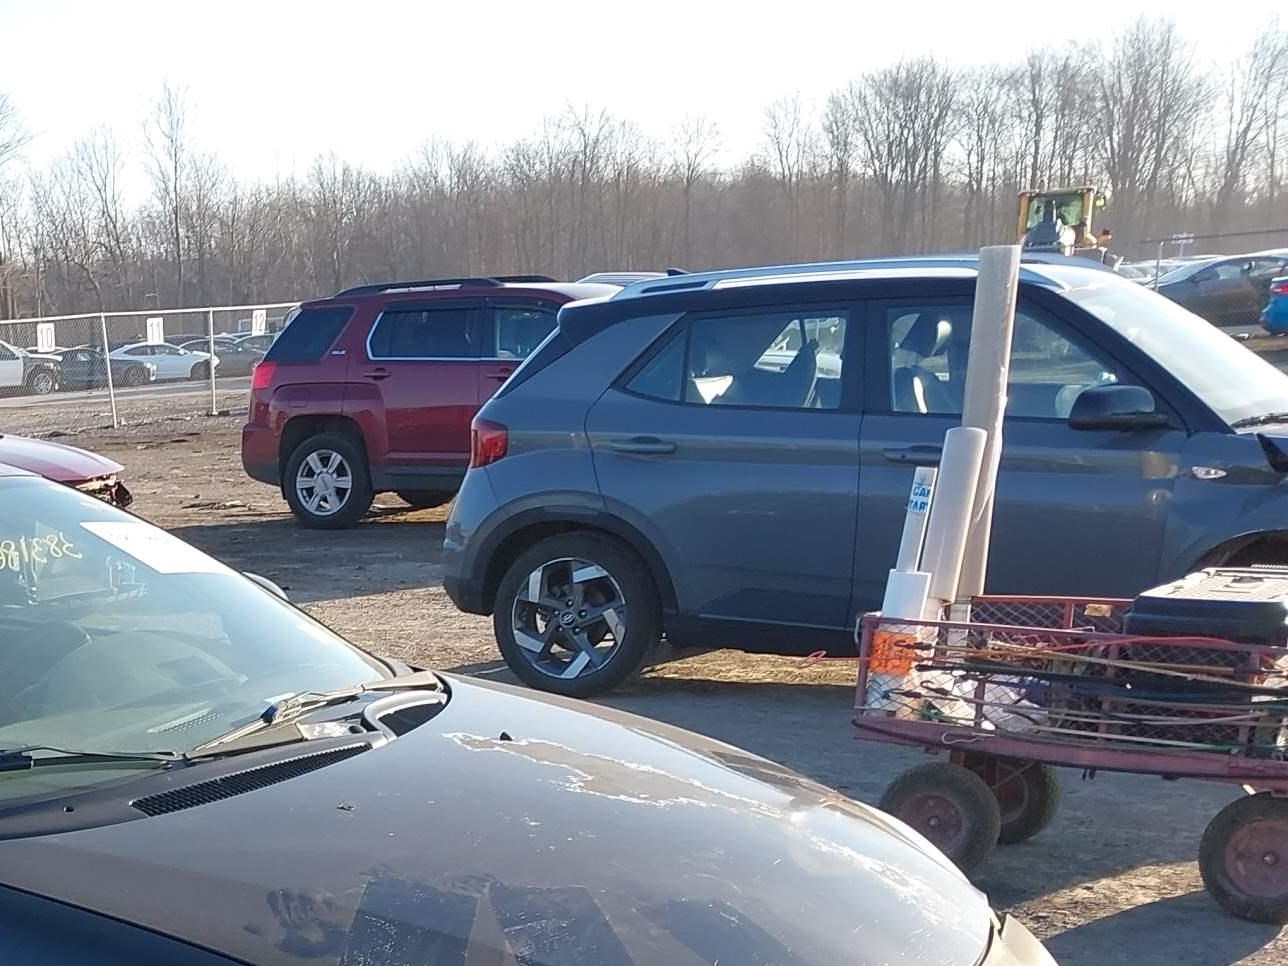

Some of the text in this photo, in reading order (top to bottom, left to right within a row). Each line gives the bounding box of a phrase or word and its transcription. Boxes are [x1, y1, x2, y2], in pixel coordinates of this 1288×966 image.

[150, 321, 161, 343] 11
[254, 313, 264, 332] 12
[40, 327, 53, 349] 10
